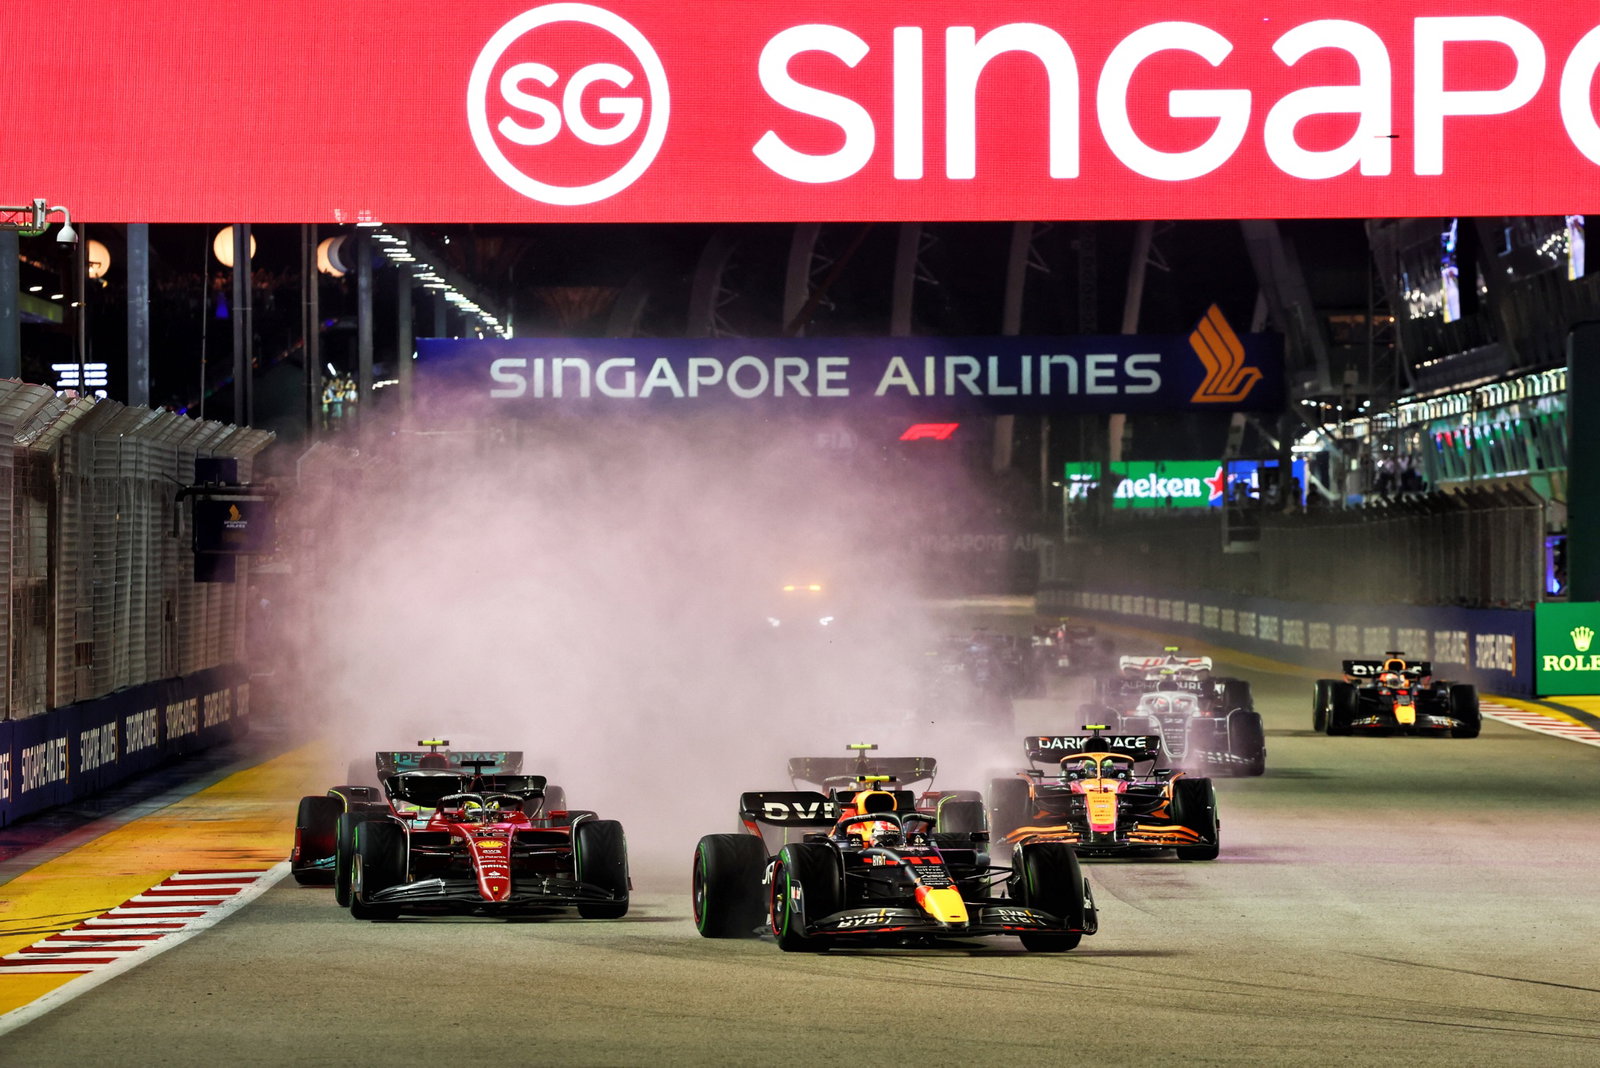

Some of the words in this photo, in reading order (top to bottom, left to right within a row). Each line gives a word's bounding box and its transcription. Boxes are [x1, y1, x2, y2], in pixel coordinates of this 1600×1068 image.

[497, 62, 645, 146] SG
[489, 356, 850, 400] SINGAPORE
[875, 353, 1162, 397] AIRLINES
